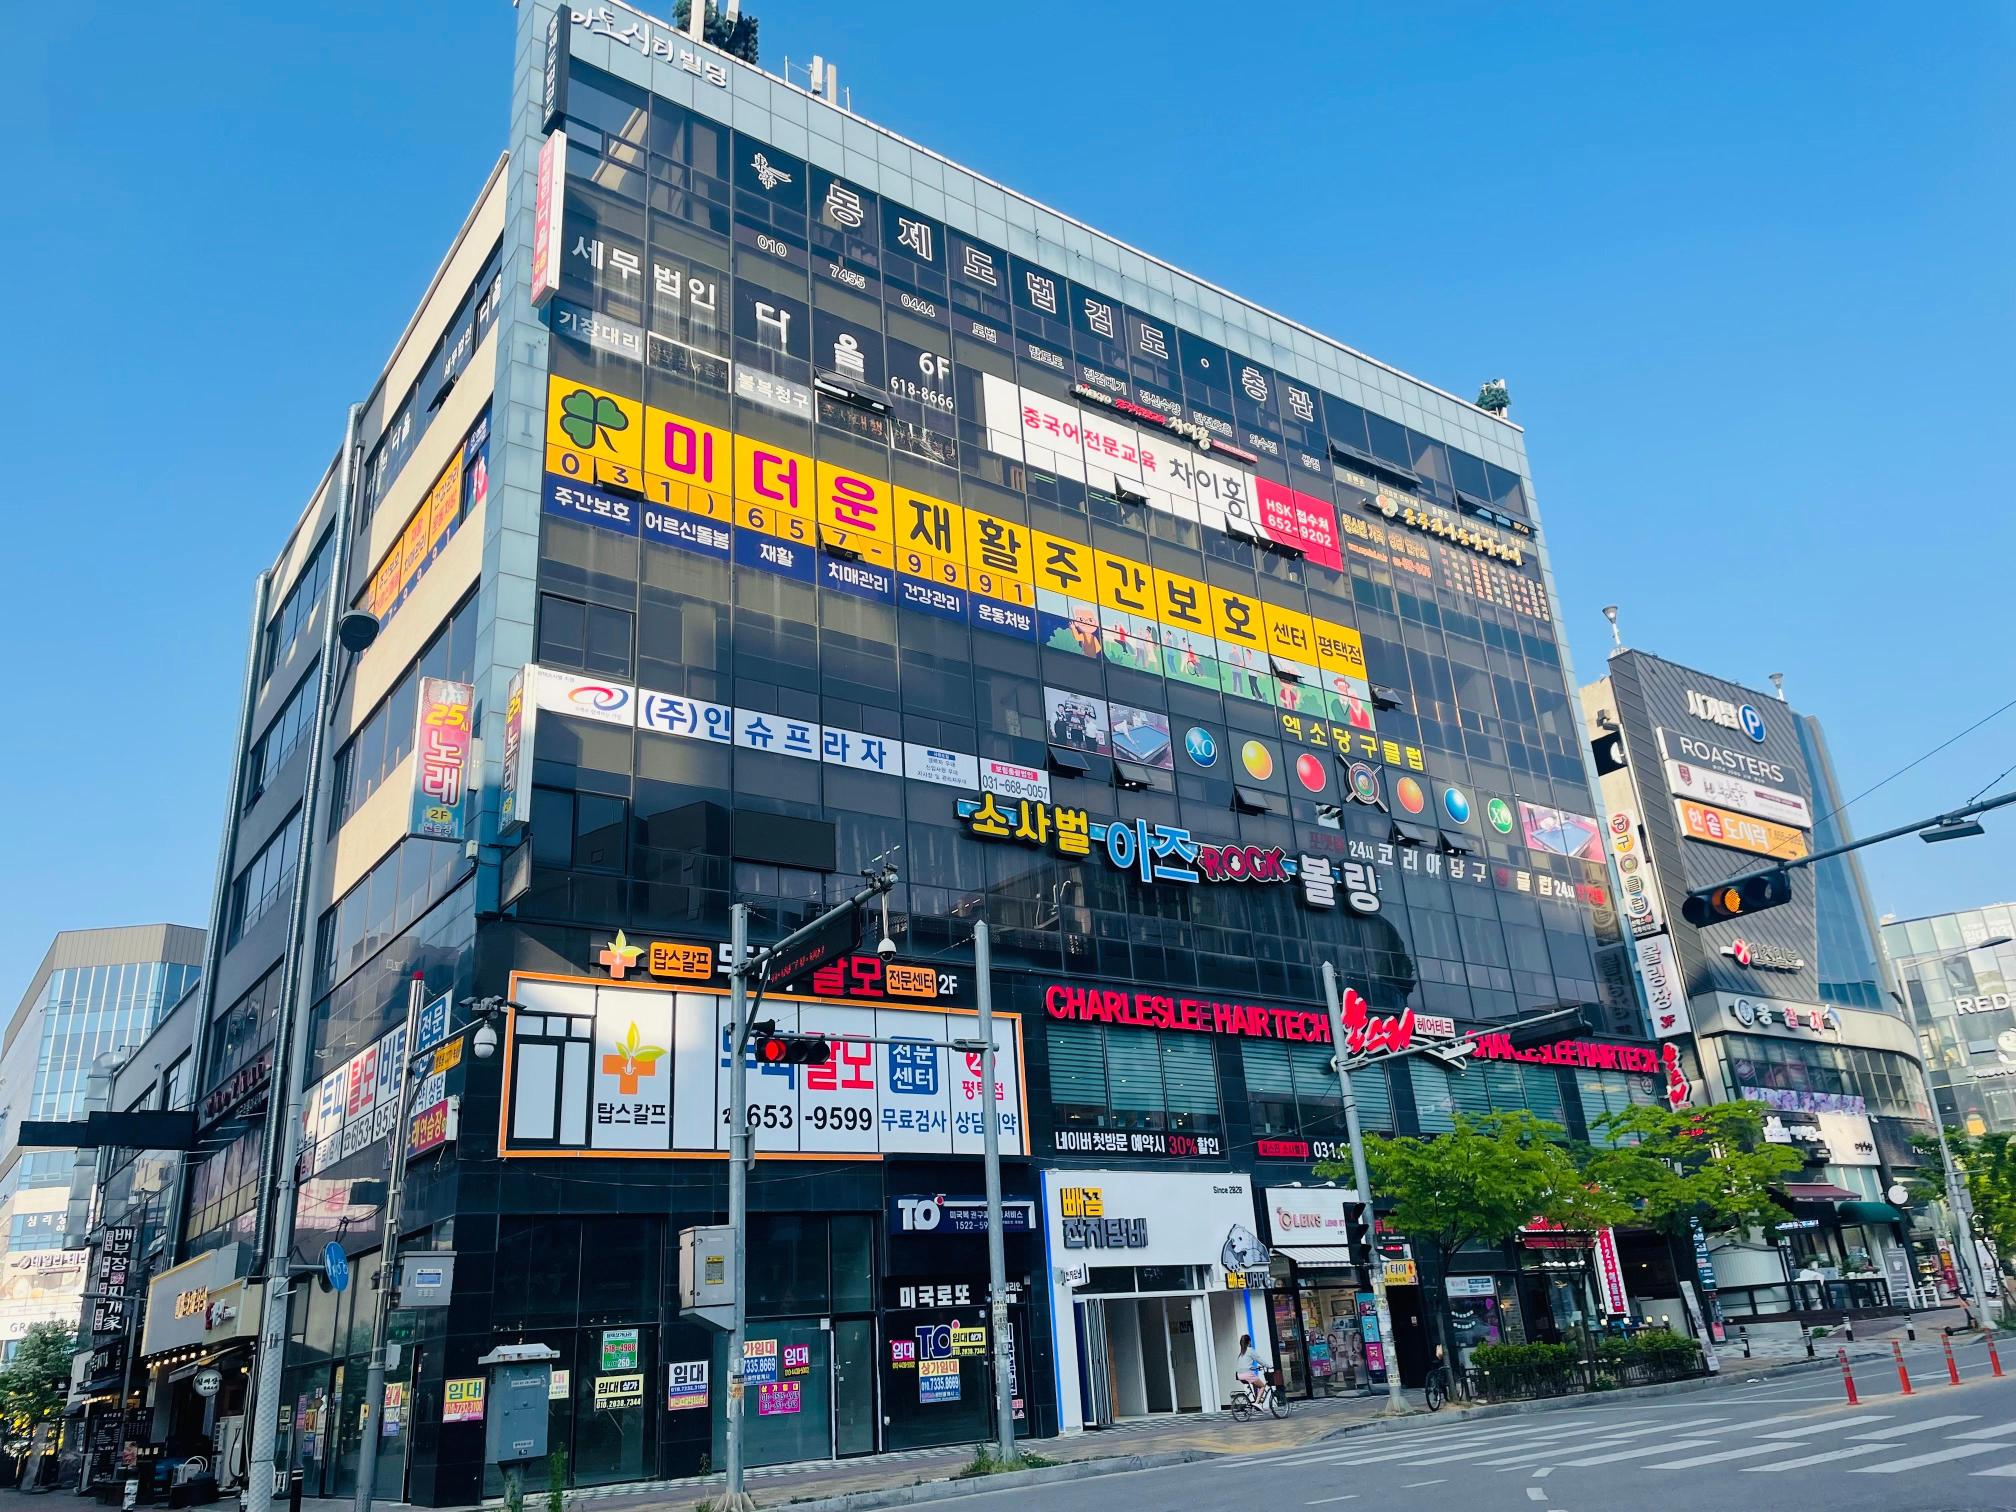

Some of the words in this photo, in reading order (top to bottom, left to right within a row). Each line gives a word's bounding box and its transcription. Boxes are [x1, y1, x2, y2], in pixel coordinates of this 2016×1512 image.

[680, 47, 727, 88] 빌딩
[757, 234, 787, 257] 010
[829, 263, 866, 290] 7455
[900, 293, 936, 318] 0444
[571, 236, 716, 311] 세무법인
[919, 352, 950, 380] 6F
[558, 309, 641, 352] 기장대리
[890, 376, 954, 410] 618-8666
[1023, 406, 1158, 473] 중국어전문교육
[1168, 457, 1246, 520] 차이홍
[1265, 497, 1293, 519] HSK
[1297, 509, 1330, 533] 접수처
[1267, 514, 1332, 548] 652-9202
[554, 485, 631, 523] 주간보호
[645, 511, 730, 550] 어르신돌봄
[760, 543, 795, 568] 재활
[828, 562, 888, 593] 치매관리
[903, 582, 960, 613] 건강관리
[979, 604, 1030, 631] 운동처방
[665, 421, 878, 532] 미더운
[1273, 621, 1308, 651] 센터
[1317, 634, 1363, 666] 평택점
[645, 694, 887, 770] (주)인슈프라자
[423, 729, 463, 808] 노래
[1679, 735, 1785, 783] ROASTERS
[982, 774, 1048, 800] 031-668-0057
[429, 808, 448, 821] 2F
[972, 793, 1091, 856] 소사벌
[1197, 844, 1291, 883] ROCK
[1300, 853, 1380, 913] 볼링
[653, 947, 710, 975] 탑스칼프
[888, 969, 936, 994] 전문센터
[939, 973, 958, 996] 2F
[1045, 984, 1213, 1033] CHARLESLEE
[1954, 993, 2011, 1017] RED
[421, 1005, 444, 1041] 전문
[1416, 1017, 1455, 1036] 헤어테크
[892, 1042, 935, 1065] 전문
[892, 1068, 935, 1092] 센터
[406, 1108, 444, 1150] 래연습장
[597, 1102, 667, 1125] 탑스칼프
[881, 1109, 948, 1134] 무료검사
[955, 1111, 1017, 1136] 상담약
[1055, 1131, 1092, 1152] 네이버
[1092, 1133, 1129, 1153] 첫방문
[1130, 1134, 1166, 1154] 예약시
[1168, 1136, 1198, 1155] 30%
[1197, 1137, 1220, 1156] 할인
[1212, 1185, 1229, 1194] Since
[897, 1199, 941, 1231] TO
[900, 1284, 971, 1309] 미국로또
[744, 1340, 776, 1356] 가임대
[784, 1346, 809, 1366] 임대
[892, 1342, 915, 1360] 임대
[448, 1381, 482, 1400] 임대
[598, 1381, 619, 1395] 임대
[674, 1363, 704, 1385] 임대
